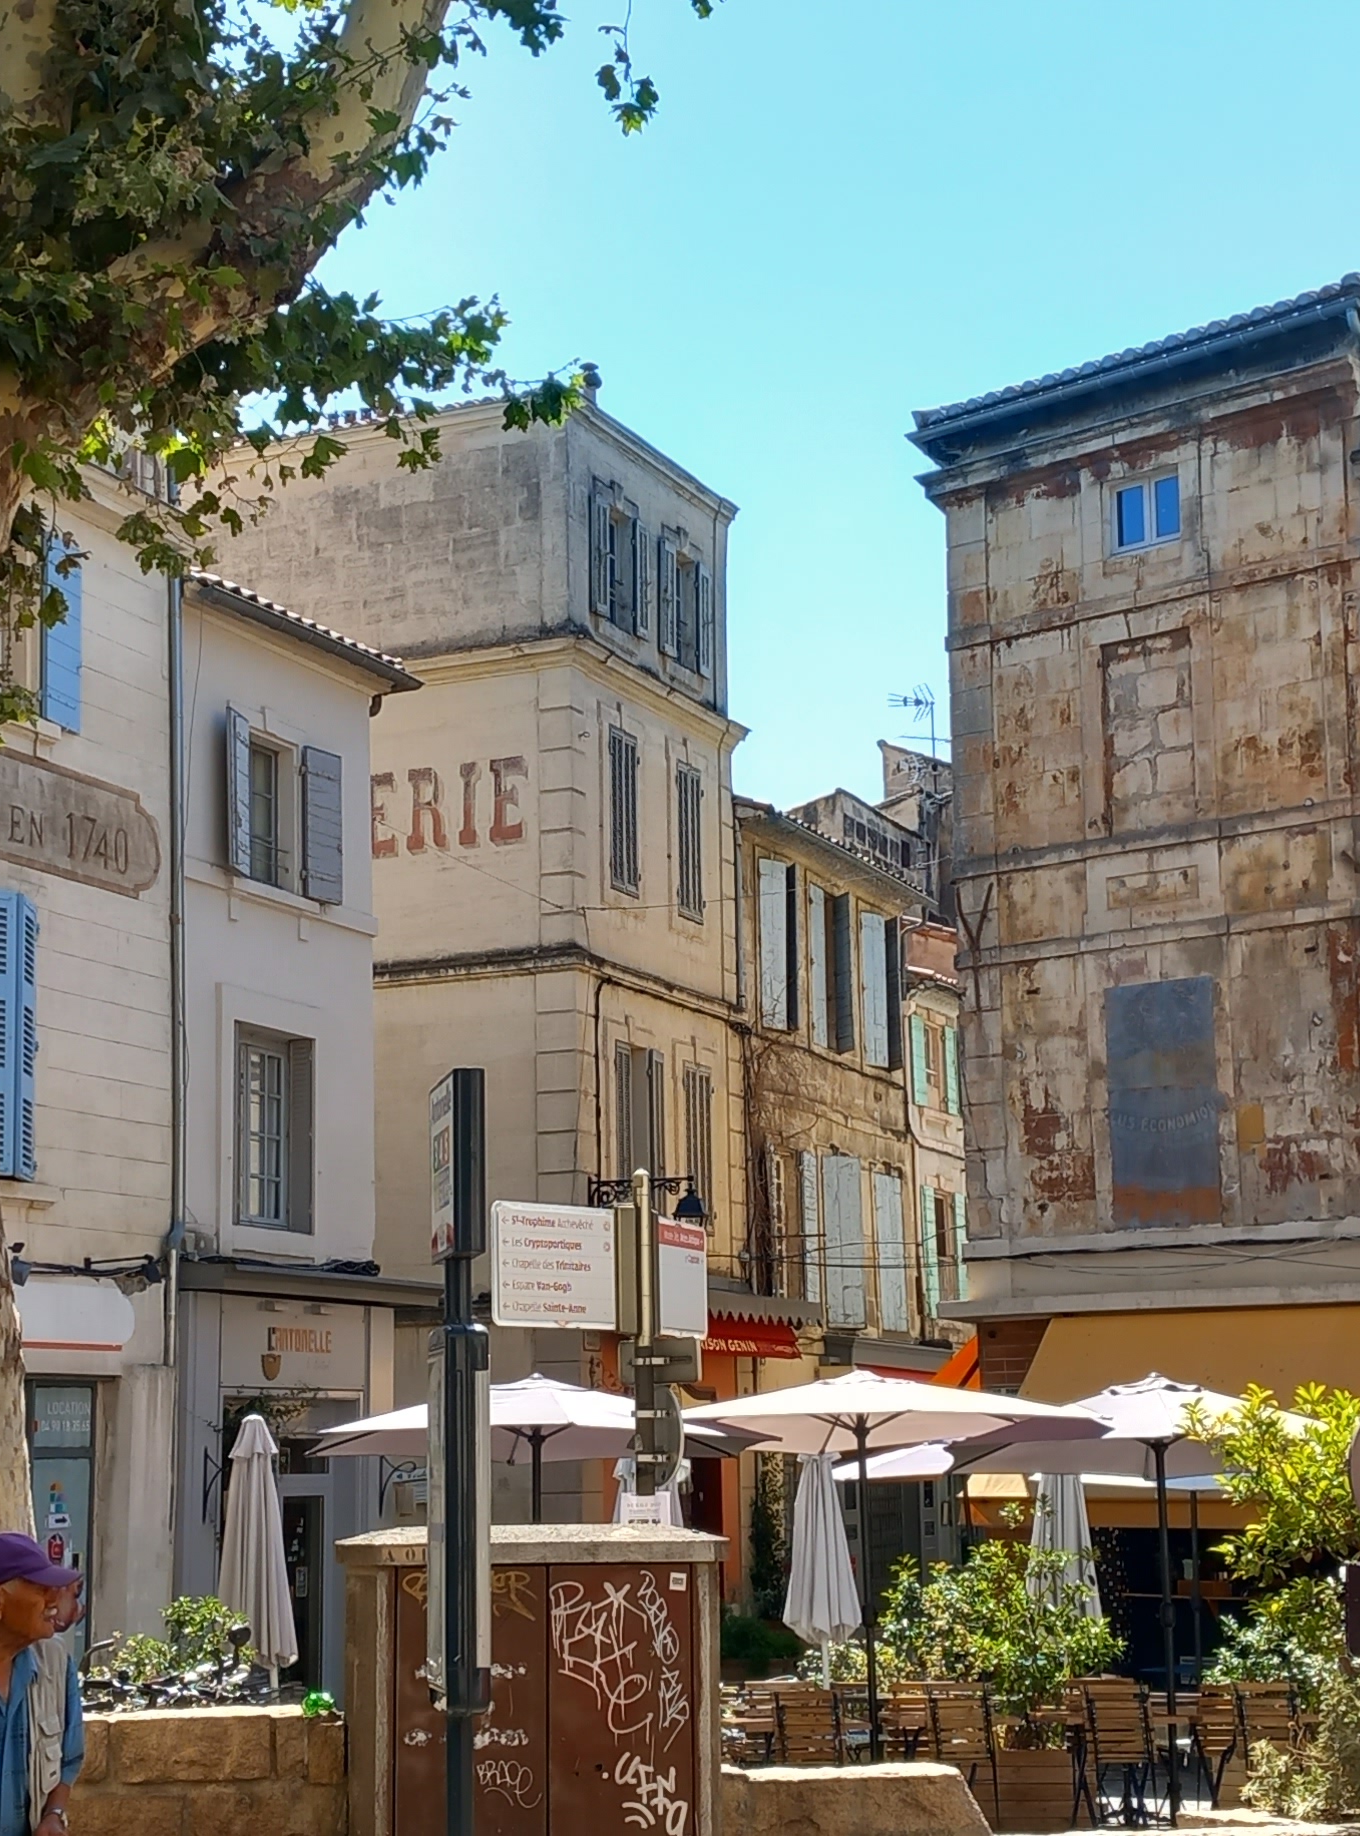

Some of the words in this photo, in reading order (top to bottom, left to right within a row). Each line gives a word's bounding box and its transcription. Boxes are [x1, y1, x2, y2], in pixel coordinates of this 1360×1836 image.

[8, 803, 44, 848] EN
[66, 811, 129, 875] 1740
[370, 754, 529, 859] ERIE
[727, 1338, 758, 1352] GENIN
